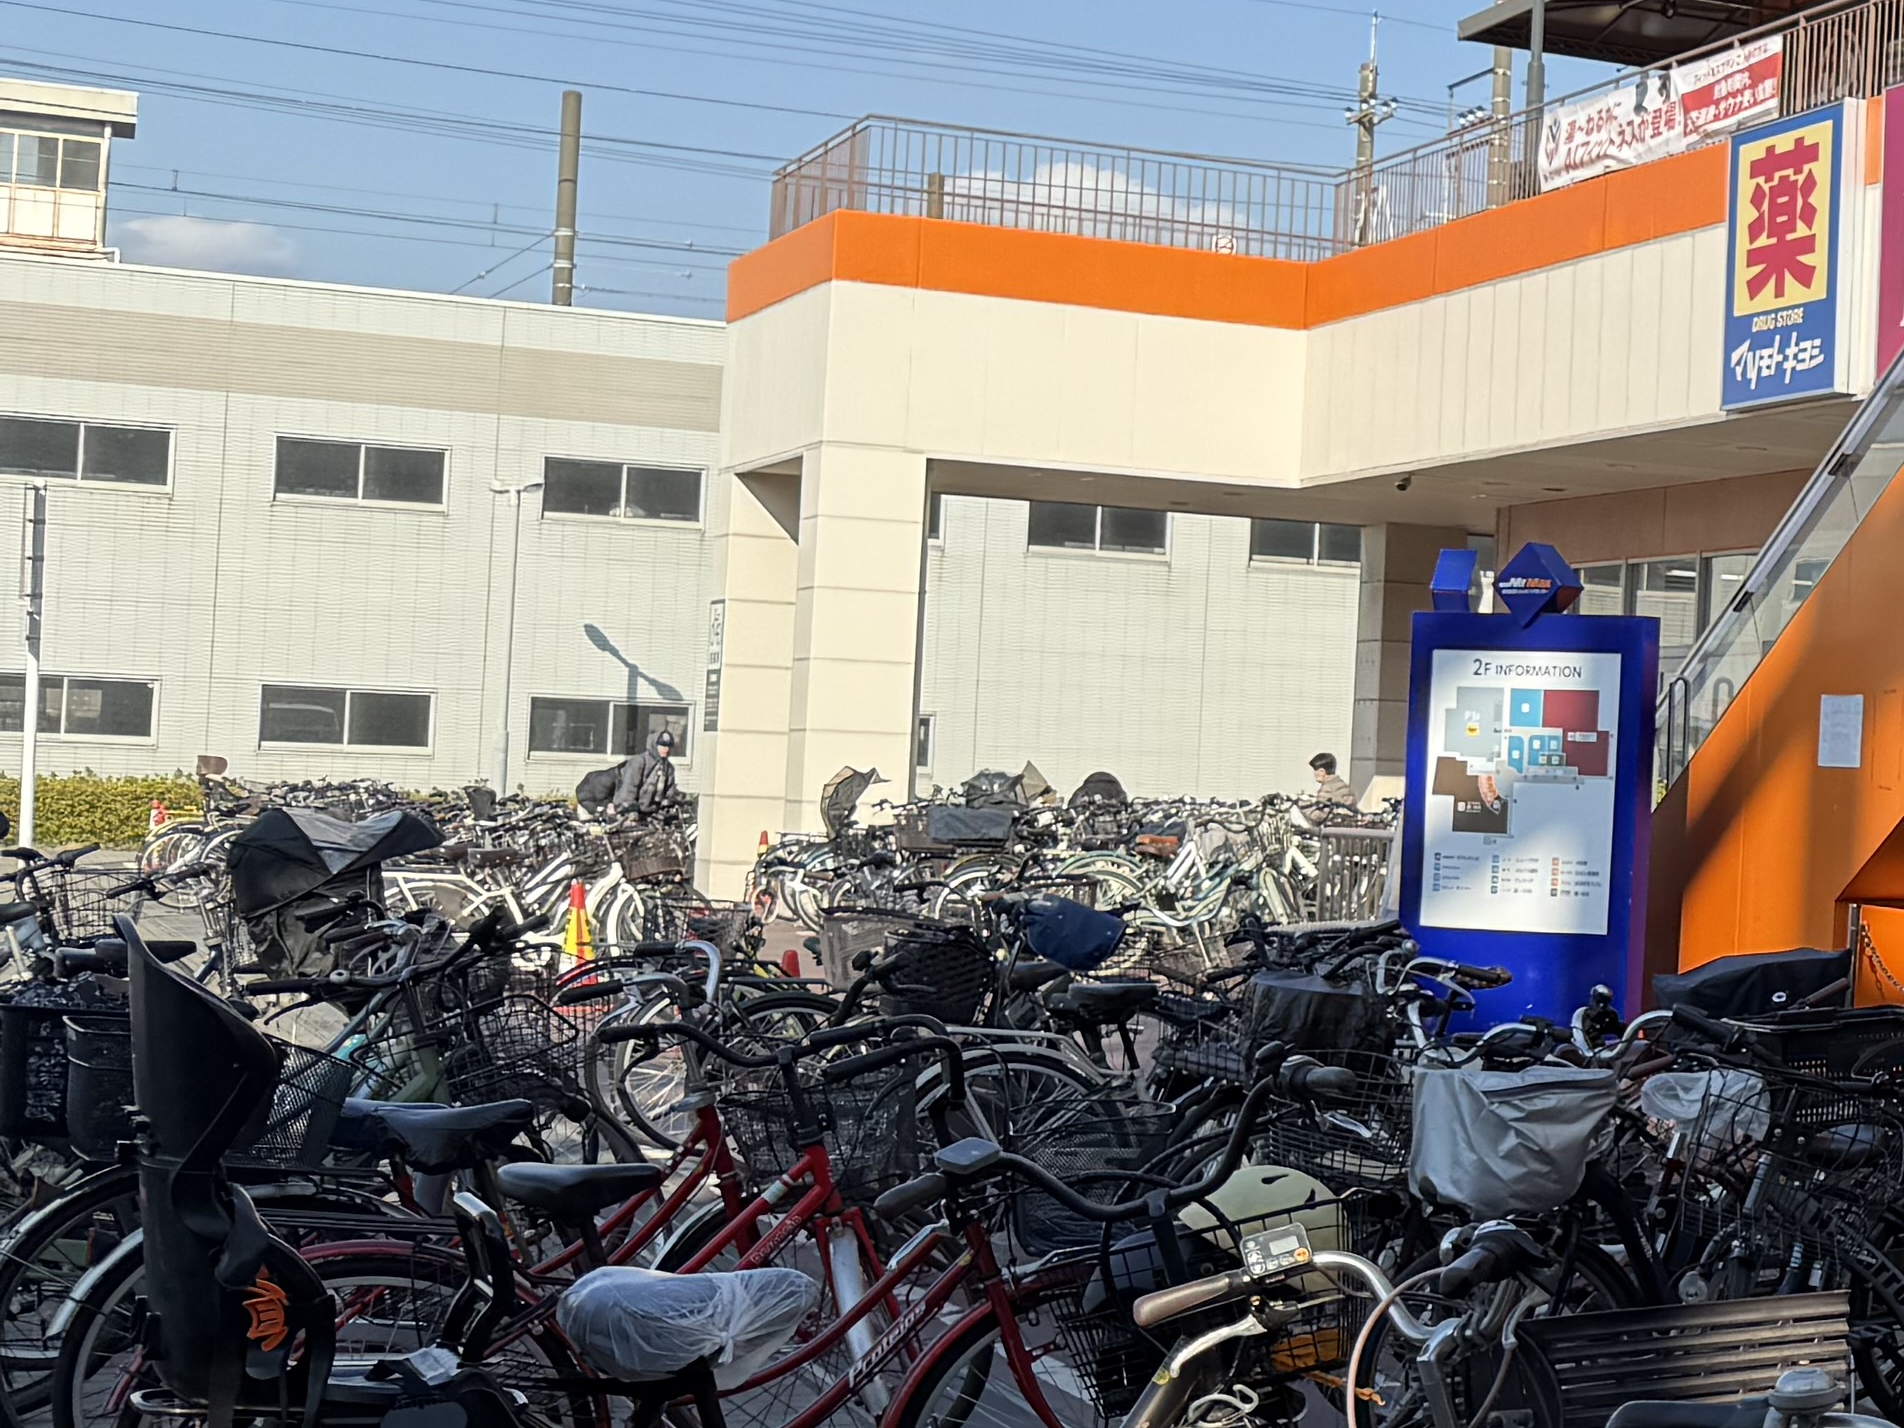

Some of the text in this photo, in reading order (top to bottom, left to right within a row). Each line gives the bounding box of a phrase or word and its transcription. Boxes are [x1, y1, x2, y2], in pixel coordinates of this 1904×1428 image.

[1746, 136, 1820, 301] 薬
[1752, 307, 1804, 332] DRUG STORE
[1731, 331, 1825, 390] マツモトキヨシ
[1473, 658, 1582, 678] 2F INFORMATION
